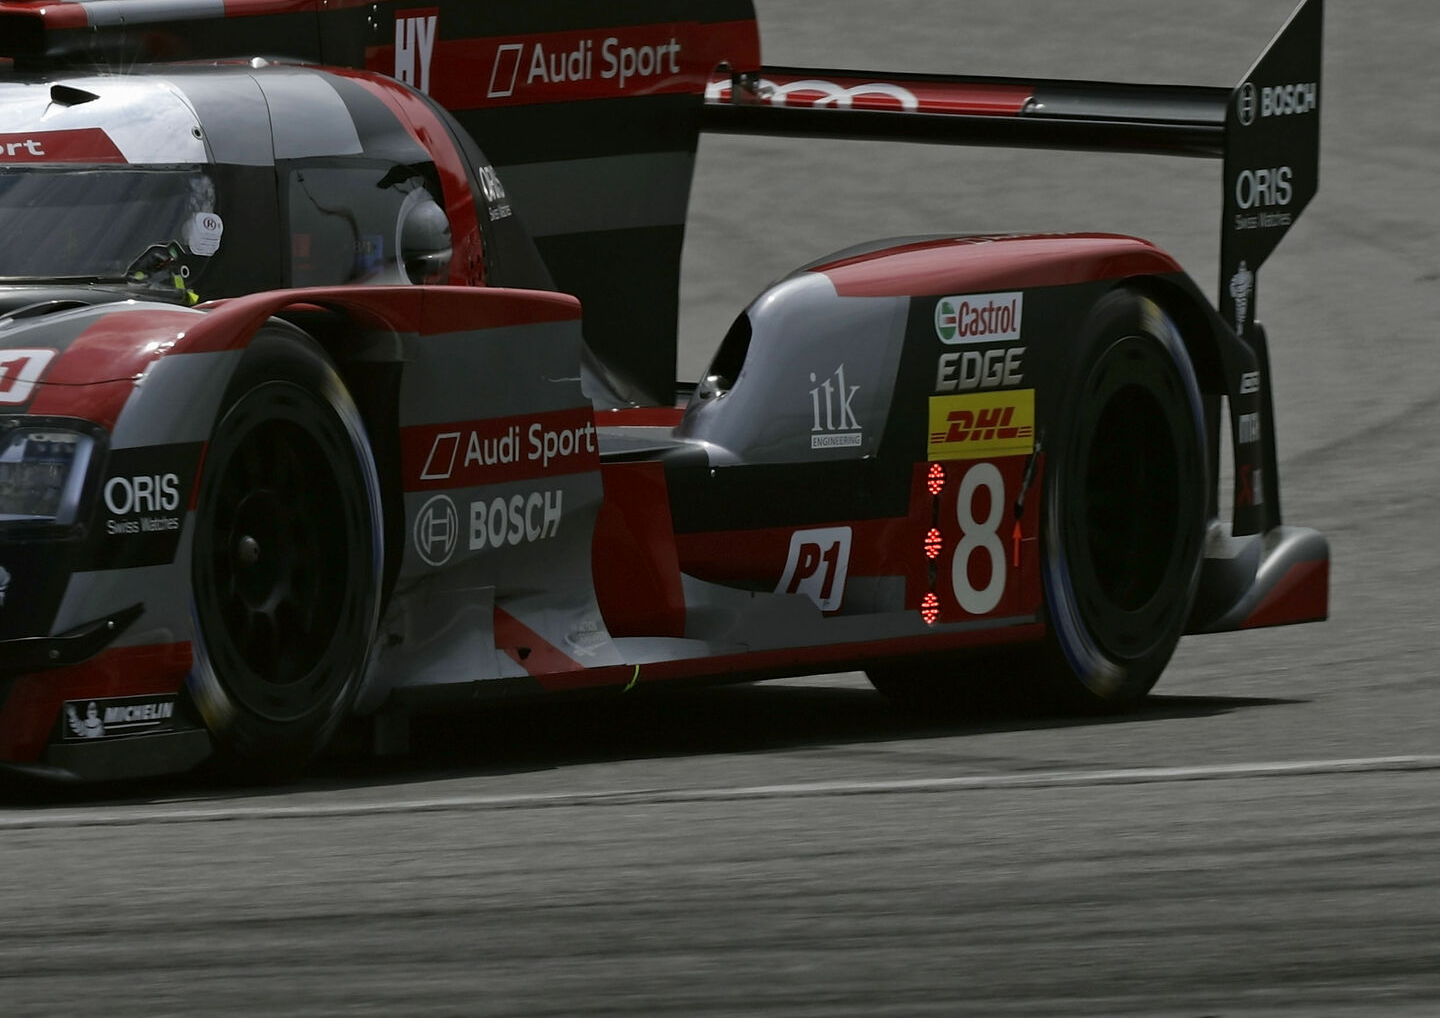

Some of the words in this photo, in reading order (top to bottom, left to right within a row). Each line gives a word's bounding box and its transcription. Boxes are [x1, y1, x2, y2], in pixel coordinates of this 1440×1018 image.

[395, 16, 437, 94] HY
[527, 40, 593, 84] Audi
[601, 38, 681, 88] Sport
[1261, 83, 1317, 117] BOSCH
[1235, 165, 1292, 210] ORIS
[958, 300, 1018, 338] Castrol
[940, 347, 1025, 391] EDGE
[809, 363, 862, 431] itk
[464, 426, 520, 466] Audi
[529, 422, 595, 468] Sport
[813, 436, 861, 447] ENGINEERING
[945, 407, 1018, 442] DHL
[104, 472, 180, 516] ORIS
[106, 519, 138, 535] Swiss
[141, 516, 179, 533] Watches
[469, 491, 563, 550] BOSCH
[952, 462, 1006, 614] 8
[787, 541, 841, 600] P1
[103, 702, 175, 723] MICHELIN
